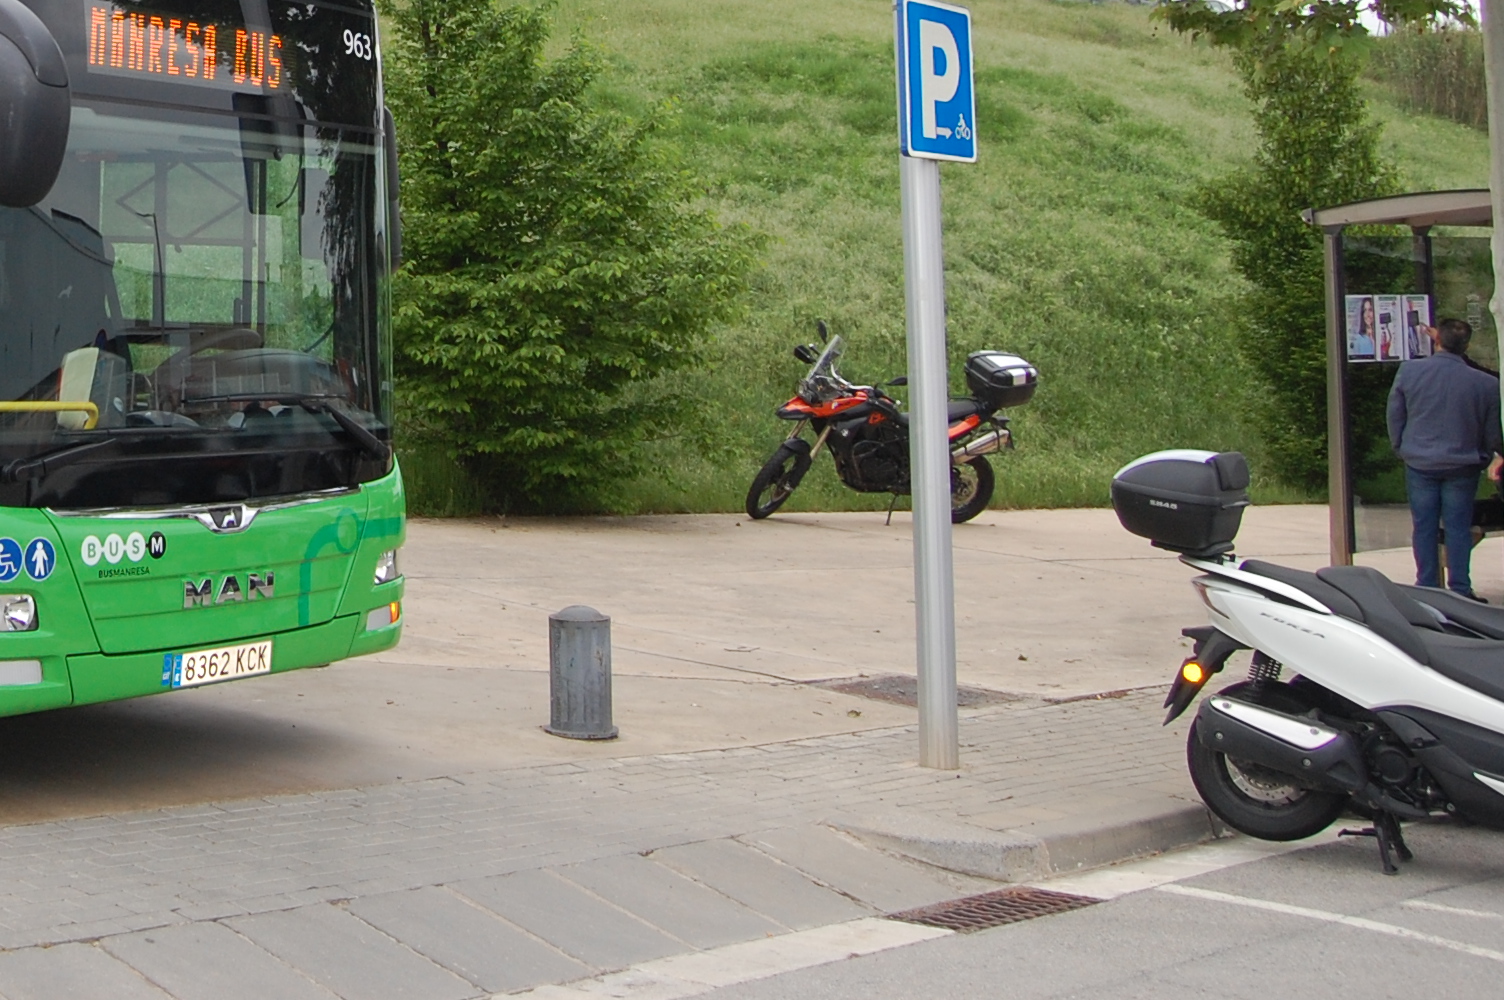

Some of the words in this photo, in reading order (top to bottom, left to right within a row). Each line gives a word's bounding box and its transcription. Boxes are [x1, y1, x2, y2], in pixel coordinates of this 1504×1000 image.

[89, 6, 216, 80] MANRESA
[234, 29, 283, 88] BUS
[343, 29, 372, 61] 963
[919, 18, 961, 139] P
[98, 566, 151, 579] BUSMANRESA
[182, 570, 275, 609] MAN
[184, 650, 231, 682] 8362
[235, 643, 268, 675] KCK
